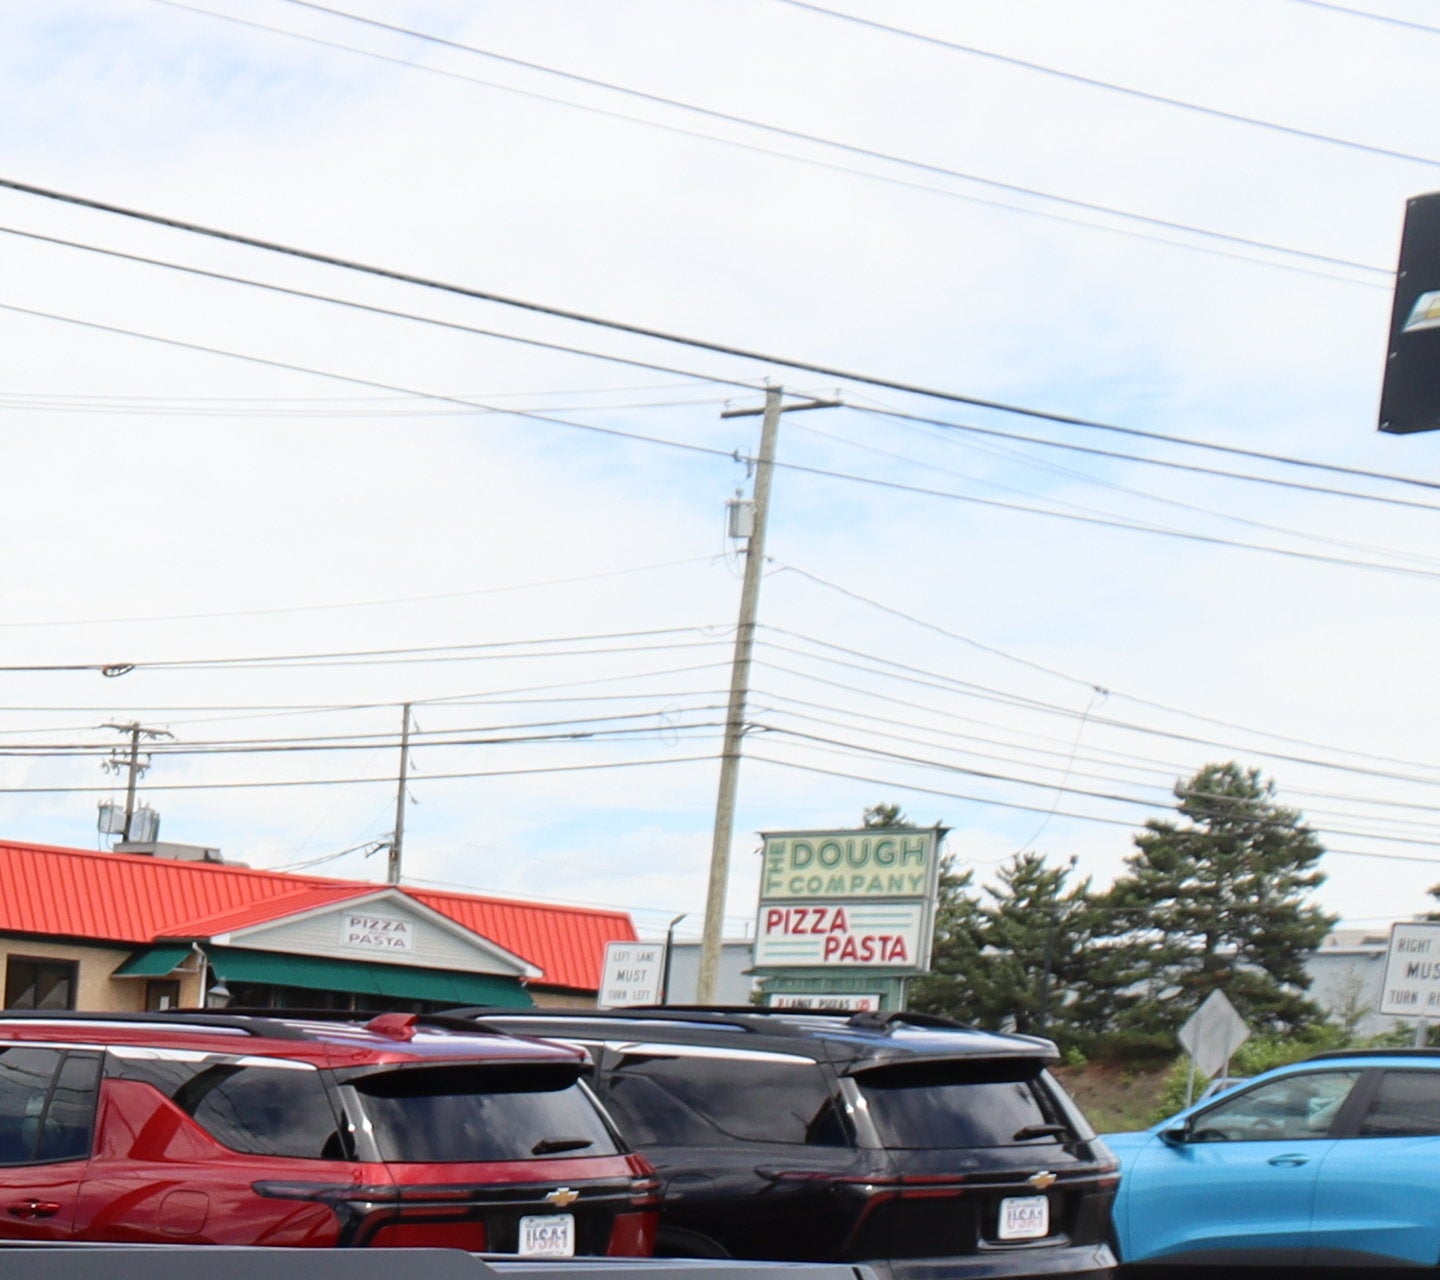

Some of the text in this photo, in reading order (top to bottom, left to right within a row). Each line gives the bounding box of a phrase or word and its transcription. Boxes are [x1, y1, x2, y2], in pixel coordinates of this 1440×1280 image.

[790, 837, 927, 870] DOUGH
[765, 841, 785, 892] THE
[788, 874, 924, 893] COMPANY
[350, 916, 407, 933] PIZZA
[766, 907, 848, 934] PIZZA
[349, 933, 406, 948] PASTA
[824, 935, 908, 962] PASTA
[1398, 938, 1431, 953] RIGHT
[617, 969, 647, 982] MUST
[1407, 961, 1440, 979] MUS
[1390, 990, 1418, 1004] TURN
